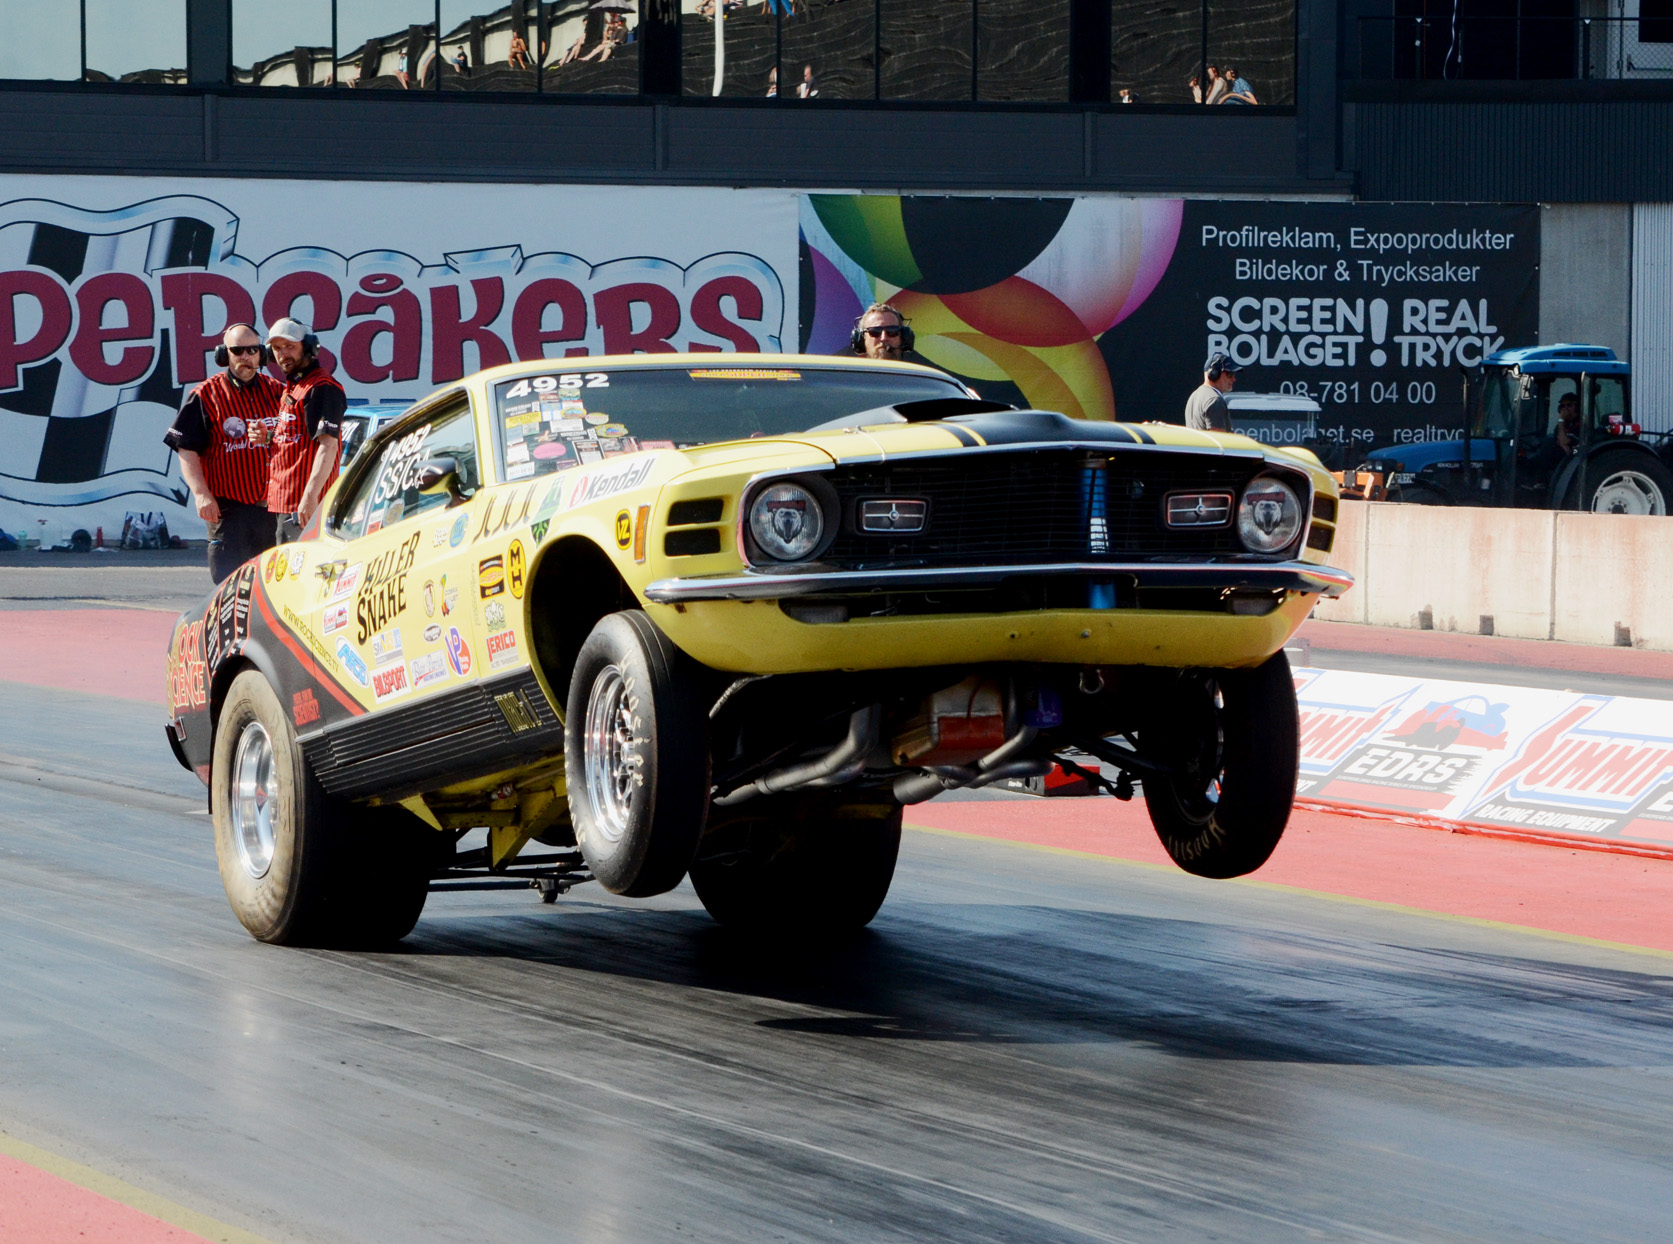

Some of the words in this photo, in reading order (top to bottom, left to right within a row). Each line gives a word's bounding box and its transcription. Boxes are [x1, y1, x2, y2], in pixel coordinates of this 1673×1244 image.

[1201, 225, 1341, 251] Profilreklam,
[1350, 227, 1514, 254] Expoprodukter
[1235, 258, 1327, 281] Bildekor
[1334, 259, 1350, 281] &
[1357, 259, 1480, 287] Trycksaker
[1207, 296, 1364, 333] SCREEN
[1403, 298, 1498, 333] REAL
[1207, 333, 1364, 367] BOLAGET
[506, 373, 610, 399] 4952
[1280, 380, 1359, 403] 08-781
[1370, 381, 1399, 404] 04
[1407, 381, 1436, 404] 00
[582, 458, 655, 502] Kendall
[357, 574, 407, 646] SNAKE
[445, 627, 462, 675] VP
[486, 630, 516, 663] JERICO
[171, 660, 207, 710] CIENCE
[373, 665, 407, 698] BILSPORT
[1343, 747, 1467, 784] EDRS
[1474, 804, 1530, 825] RACING
[1524, 813, 1616, 832] EQUIPMENT
